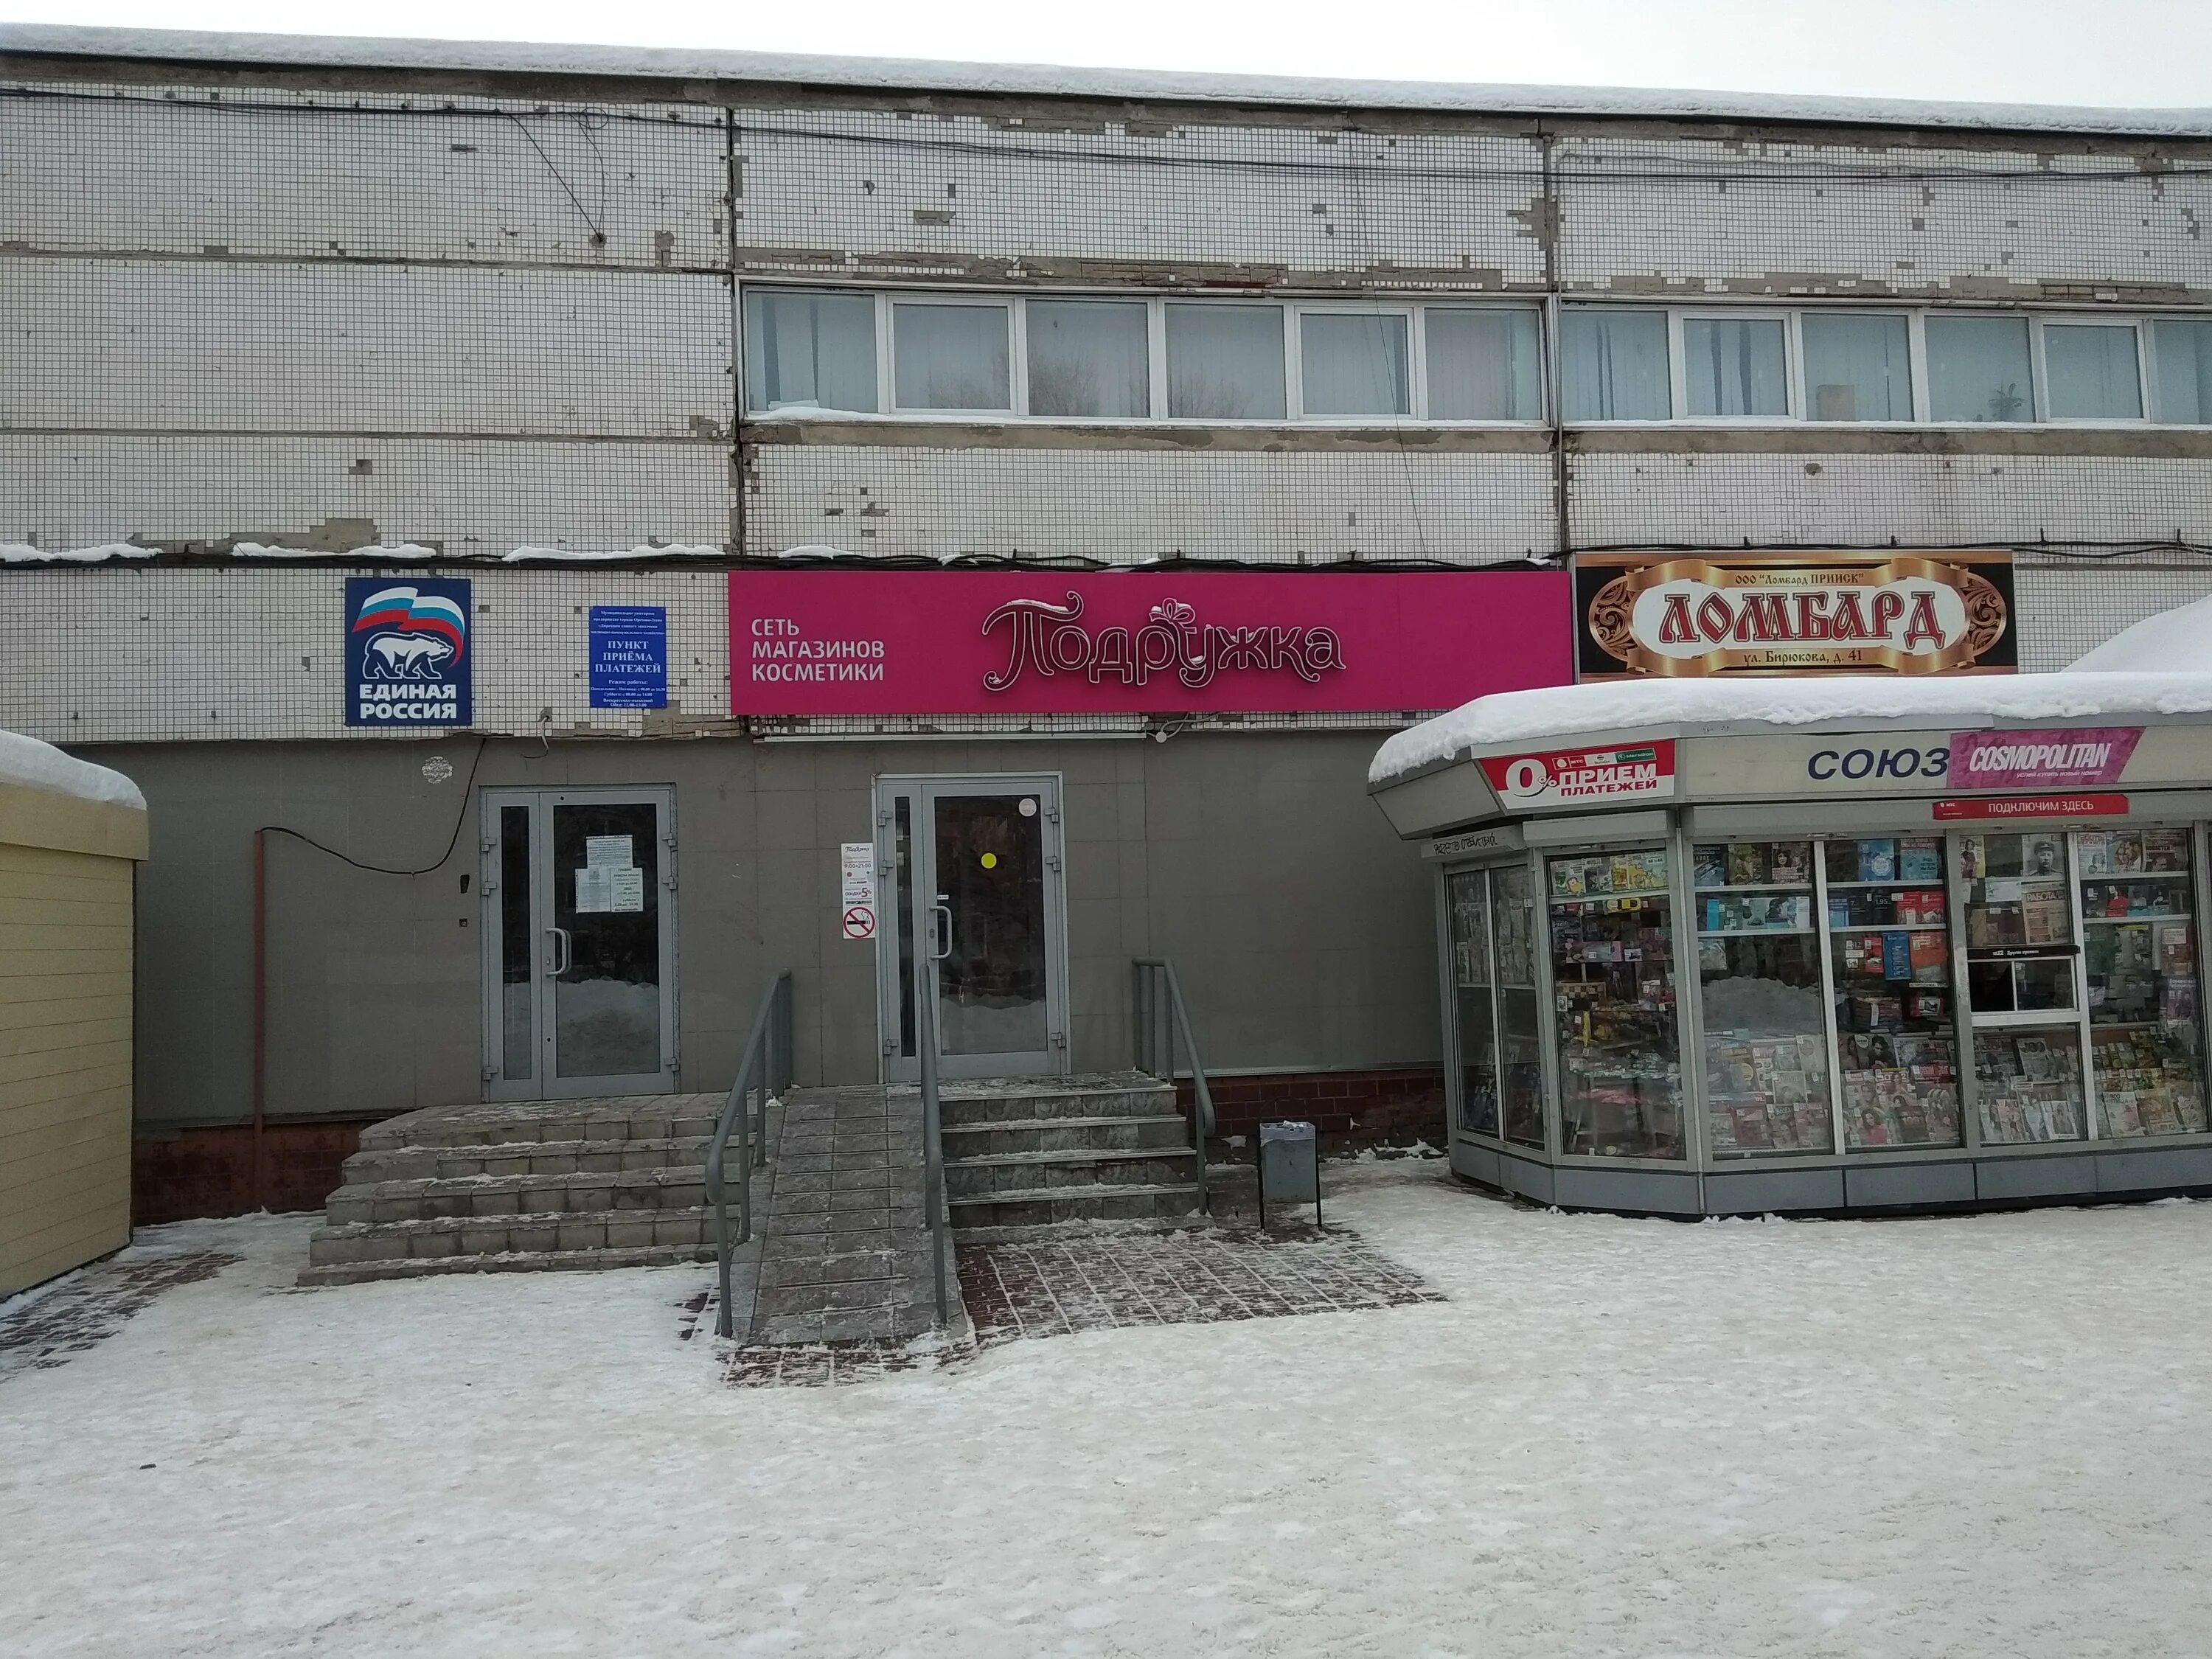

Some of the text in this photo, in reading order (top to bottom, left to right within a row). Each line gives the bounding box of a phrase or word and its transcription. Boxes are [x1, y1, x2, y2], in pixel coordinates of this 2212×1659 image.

[1735, 574, 1756, 585] ООО
[751, 618, 800, 636] СЕТЬ
[1659, 591, 1945, 650] ЛОМБАРД
[608, 641, 649, 650] ПУНКТ
[752, 640, 885, 658] МАГАЗИНОВ
[981, 590, 1347, 692] Подружка
[603, 650, 653, 661] ПРИЁМА
[1743, 650, 1863, 667] ул. Бирюкова, д. 41
[595, 662, 661, 673] ПЛАТЕЖЕЙ
[752, 663, 884, 682] КОСМЕТИКИ
[359, 684, 456, 700] ЕДИНАЯ
[360, 702, 457, 720] РОССИЯ
[1808, 747, 1949, 780] СОЮЗ
[1969, 743, 2112, 772] COSMOPOLITAN
[1559, 762, 1657, 786] ПРИЕМ
[1560, 777, 1658, 797] ПЛАТЕЖЕЙ
[1989, 800, 2094, 814] ПОДКЛЮЧИМ ЗДЕСЬ
